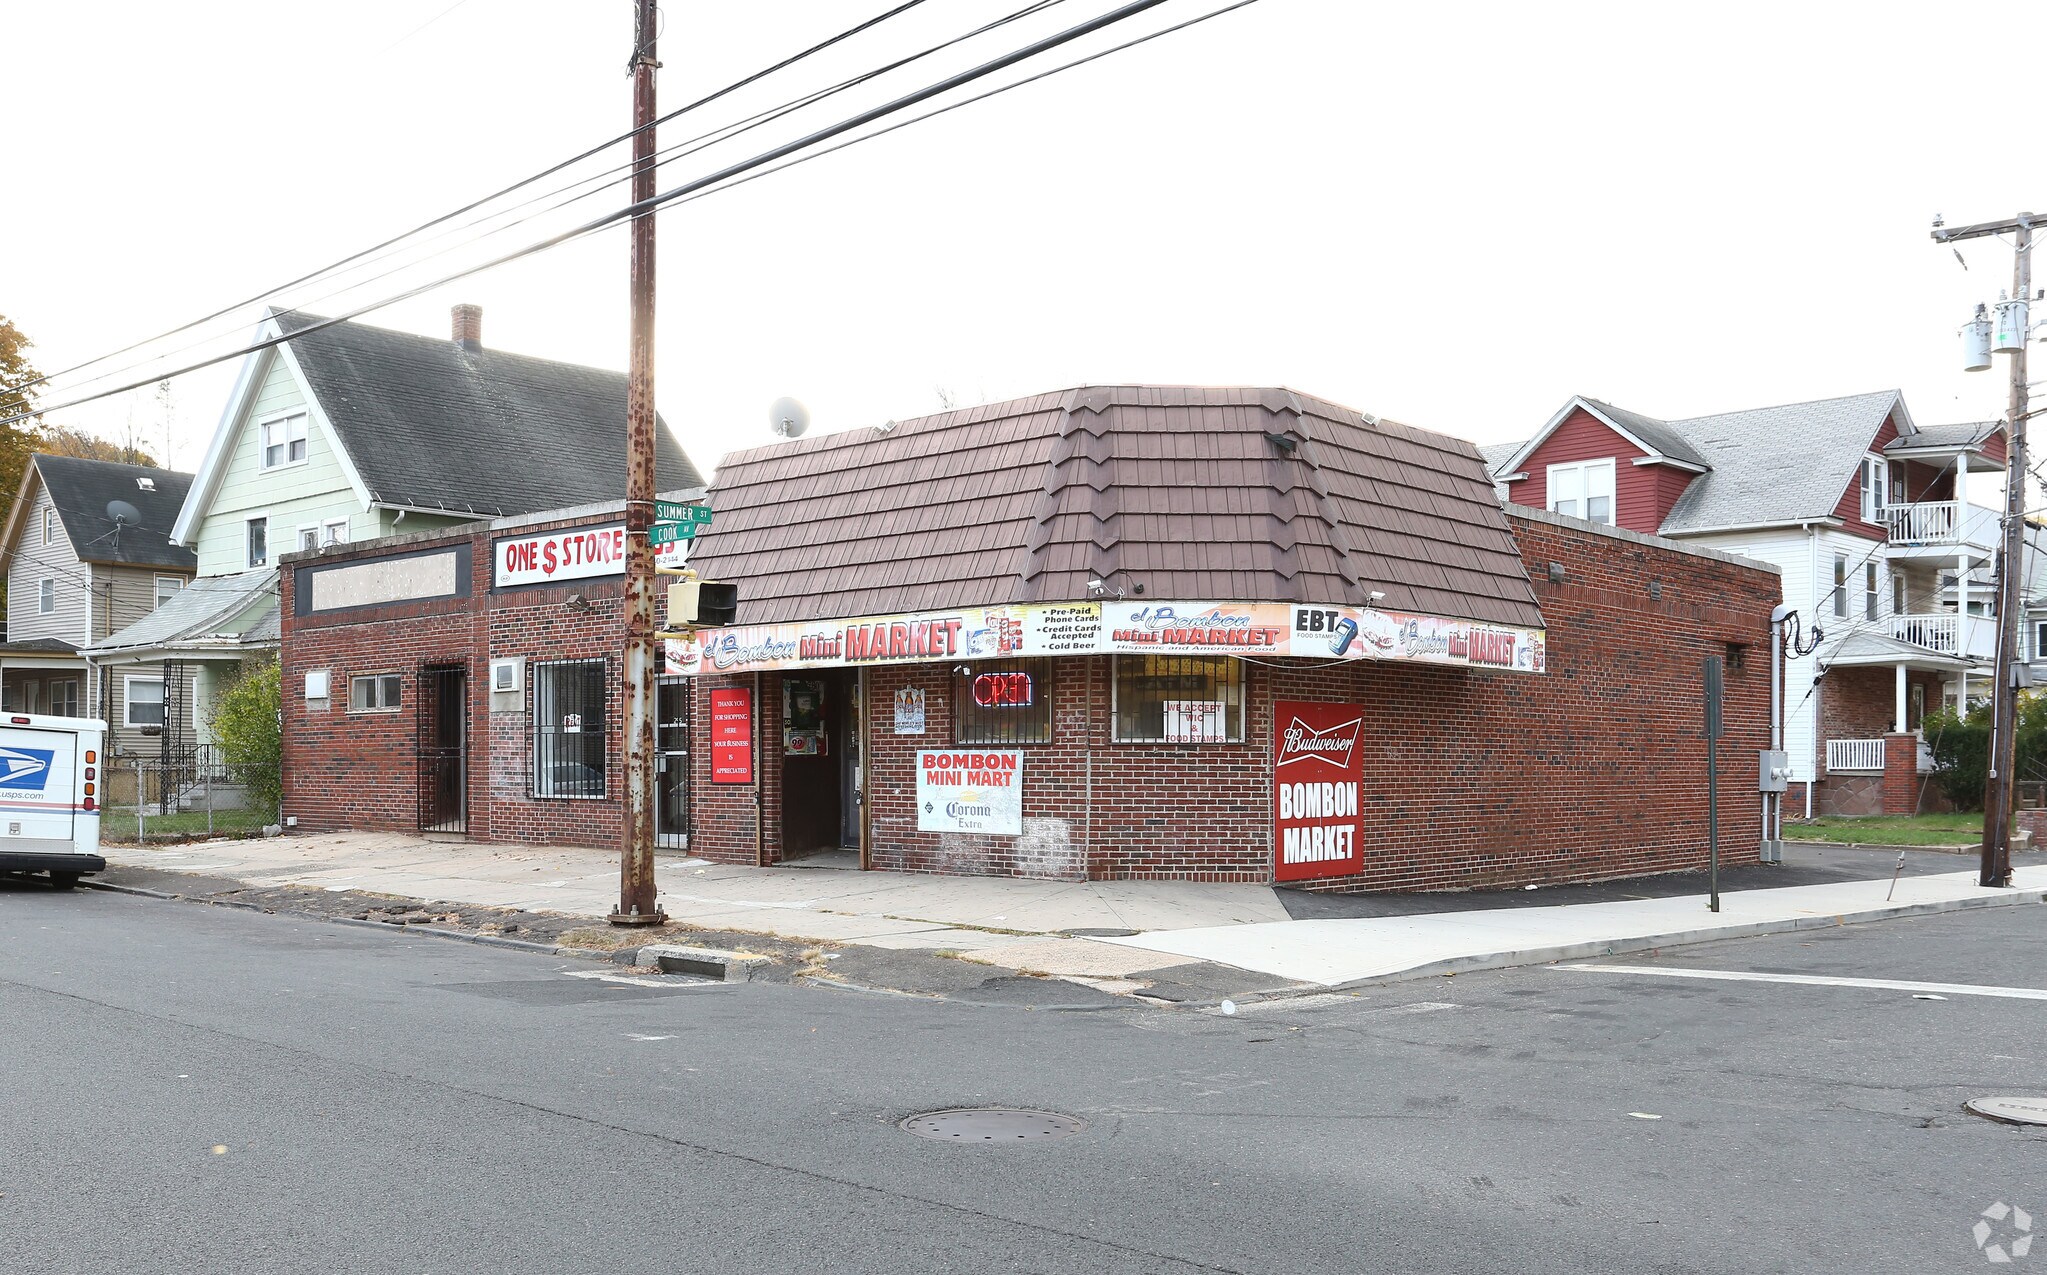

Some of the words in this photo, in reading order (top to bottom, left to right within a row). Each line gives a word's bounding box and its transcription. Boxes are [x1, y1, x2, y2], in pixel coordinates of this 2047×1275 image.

[657, 505, 693, 520] SUMMER
[658, 526, 678, 541] COOK
[683, 525, 690, 533] AV
[506, 542, 538, 573] ONE
[542, 539, 557, 578] $
[563, 530, 623, 567] STORE
[1050, 607, 1091, 615] Pre-Paid
[1130, 607, 1150, 622] el
[1145, 606, 1250, 629] Bombon
[1042, 625, 1072, 633] Credit
[1296, 609, 1339, 632] EBT
[704, 635, 717, 658] el
[714, 633, 797, 668] Bombon
[800, 631, 842, 662] Mini
[845, 617, 962, 662] MARKET
[1051, 632, 1094, 640] Accepted
[1112, 629, 1159, 642] Mini
[1162, 628, 1280, 645] MARKET
[1448, 630, 1468, 658] Mini
[1469, 627, 1516, 667] MARKET
[973, 676, 1028, 703] OPEN
[1168, 704, 1181, 712] WE
[1184, 704, 1221, 712] ACCEPT
[1191, 724, 1198, 732] &
[1284, 729, 1353, 753] Budweiser
[923, 754, 1016, 769] BOMBON
[927, 771, 961, 786] MINI
[967, 772, 1012, 787] MART
[1280, 782, 1357, 820] BOMBON
[946, 801, 991, 819] Corona
[959, 818, 982, 829] Extra
[1283, 825, 1355, 864] MARKET
